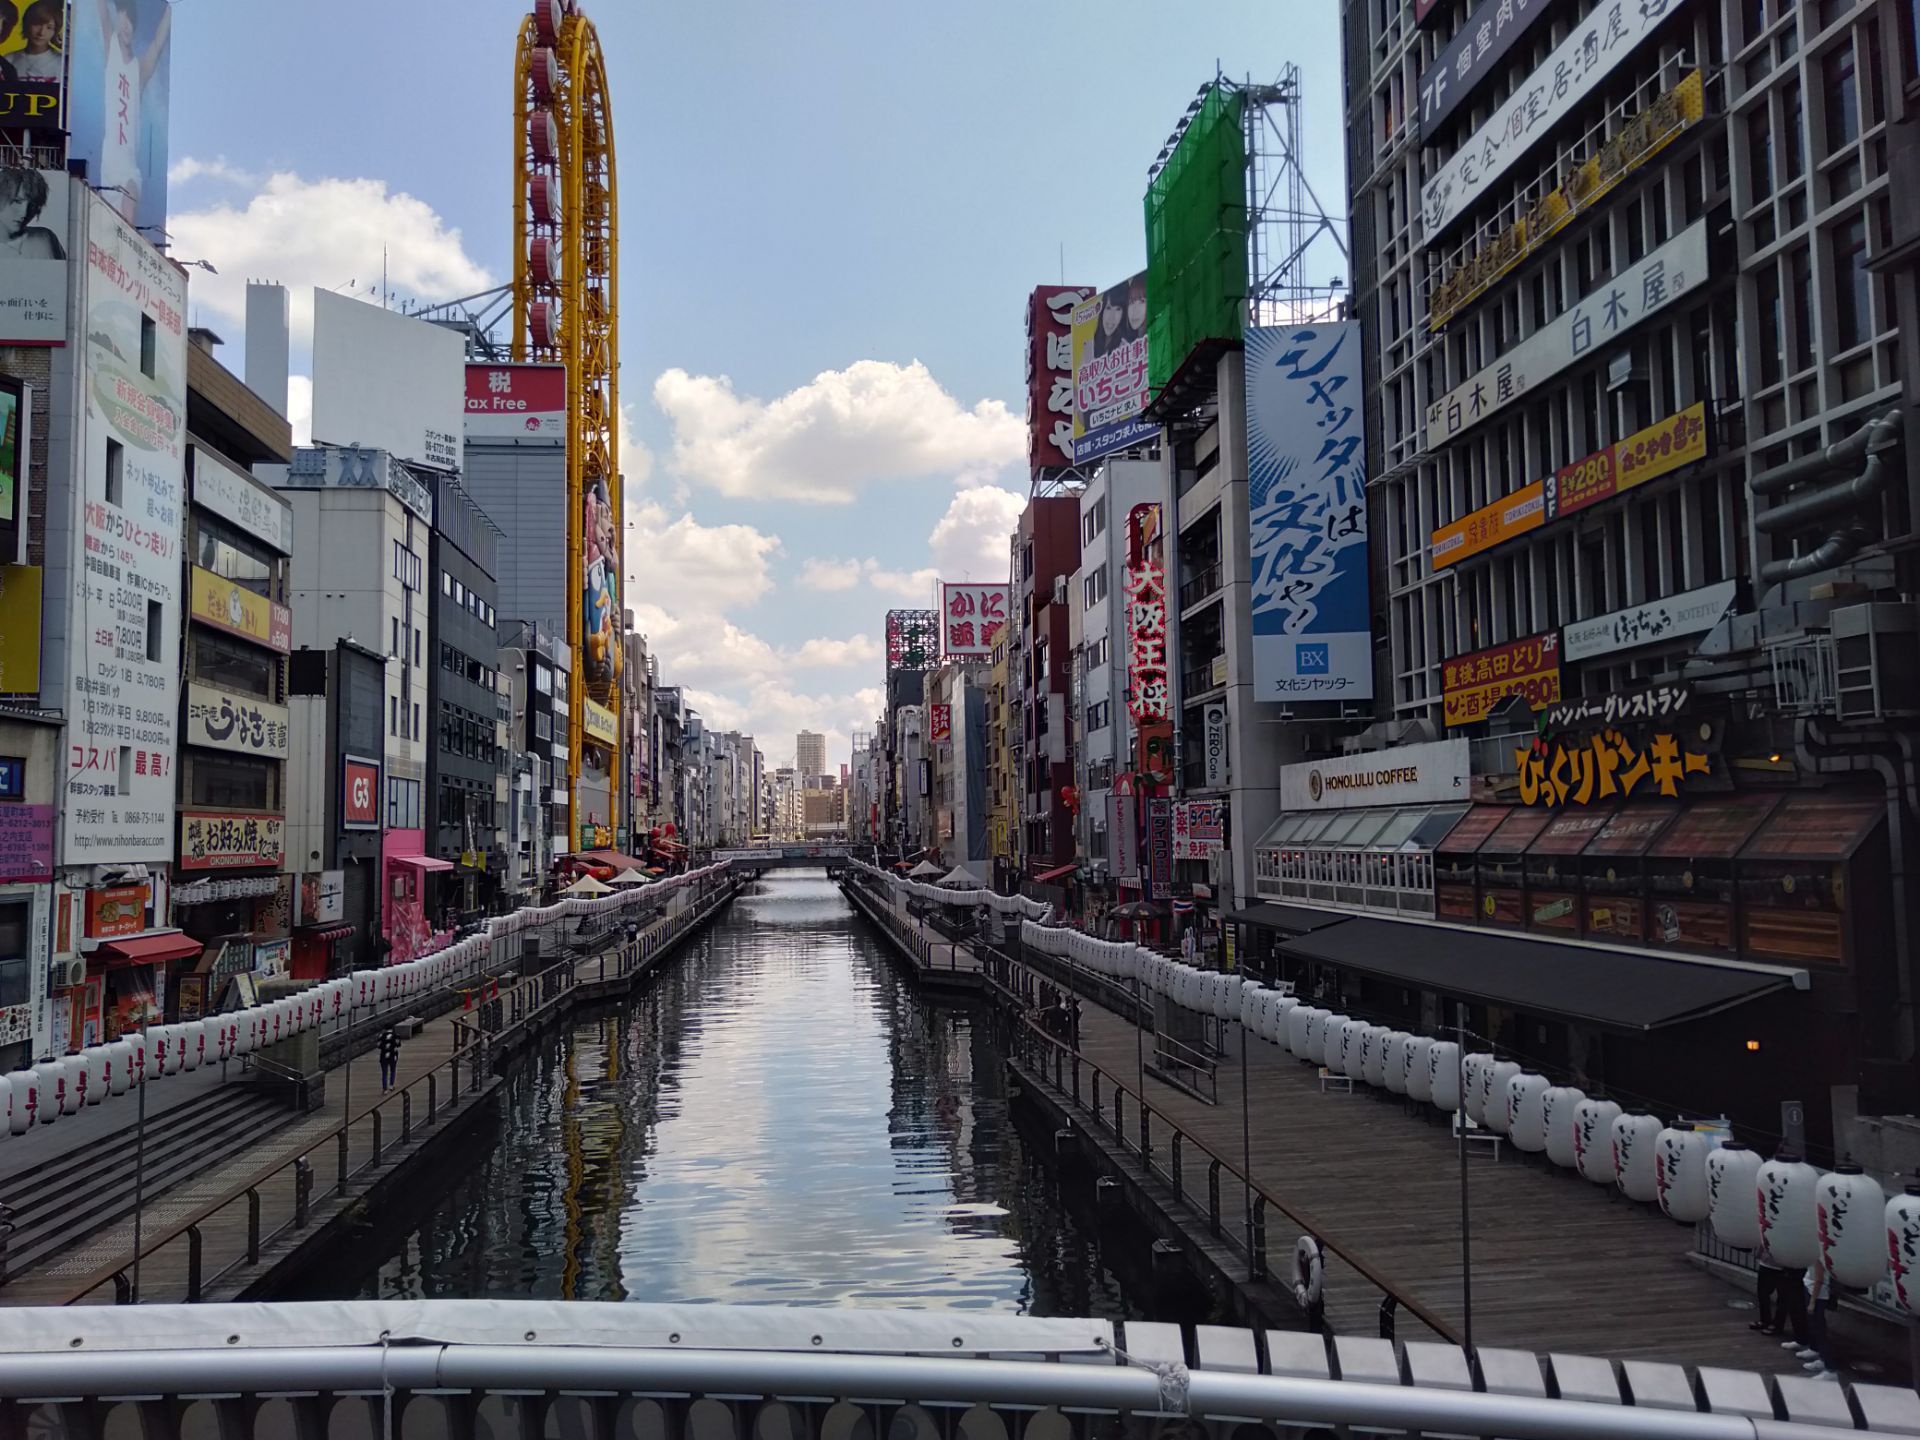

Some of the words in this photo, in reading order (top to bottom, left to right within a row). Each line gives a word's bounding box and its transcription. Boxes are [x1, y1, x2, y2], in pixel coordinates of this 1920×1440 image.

[118, 72, 131, 145] ホスト
[1422, 67, 1447, 123] 7F
[87, 240, 182, 336] 日本原カンツリー倶楽部
[1572, 260, 1668, 356] 白木屋
[488, 372, 512, 393] 税
[1429, 403, 1443, 425] 4F
[1447, 363, 1514, 433] 白木屋
[493, 397, 527, 410] Free
[1468, 511, 1499, 546] 鳥貴族
[949, 591, 1005, 618] かに
[1129, 561, 1167, 717] 大阪王将
[98, 662, 118, 679] ロッジ
[1300, 650, 1326, 667] BX
[1444, 641, 1542, 690] 豊後高田どり
[1542, 633, 1558, 652] 2F
[1549, 687, 1688, 725] ハンバーグレストラン
[206, 697, 266, 749] うなぎ
[1209, 726, 1220, 757] ZERO
[71, 746, 117, 772] コスパ
[135, 750, 170, 777] 最高!
[1325, 771, 1374, 790] HONOLULU
[1376, 766, 1418, 784] COFFEE
[1515, 728, 1710, 808] びっくりドンキー
[70, 782, 116, 797] 幹部スタッフ募集
[353, 777, 369, 809] G3
[75, 809, 104, 824] 予約受付
[206, 819, 258, 853] お好み焼
[210, 856, 256, 866] OKONOMIYAKI
